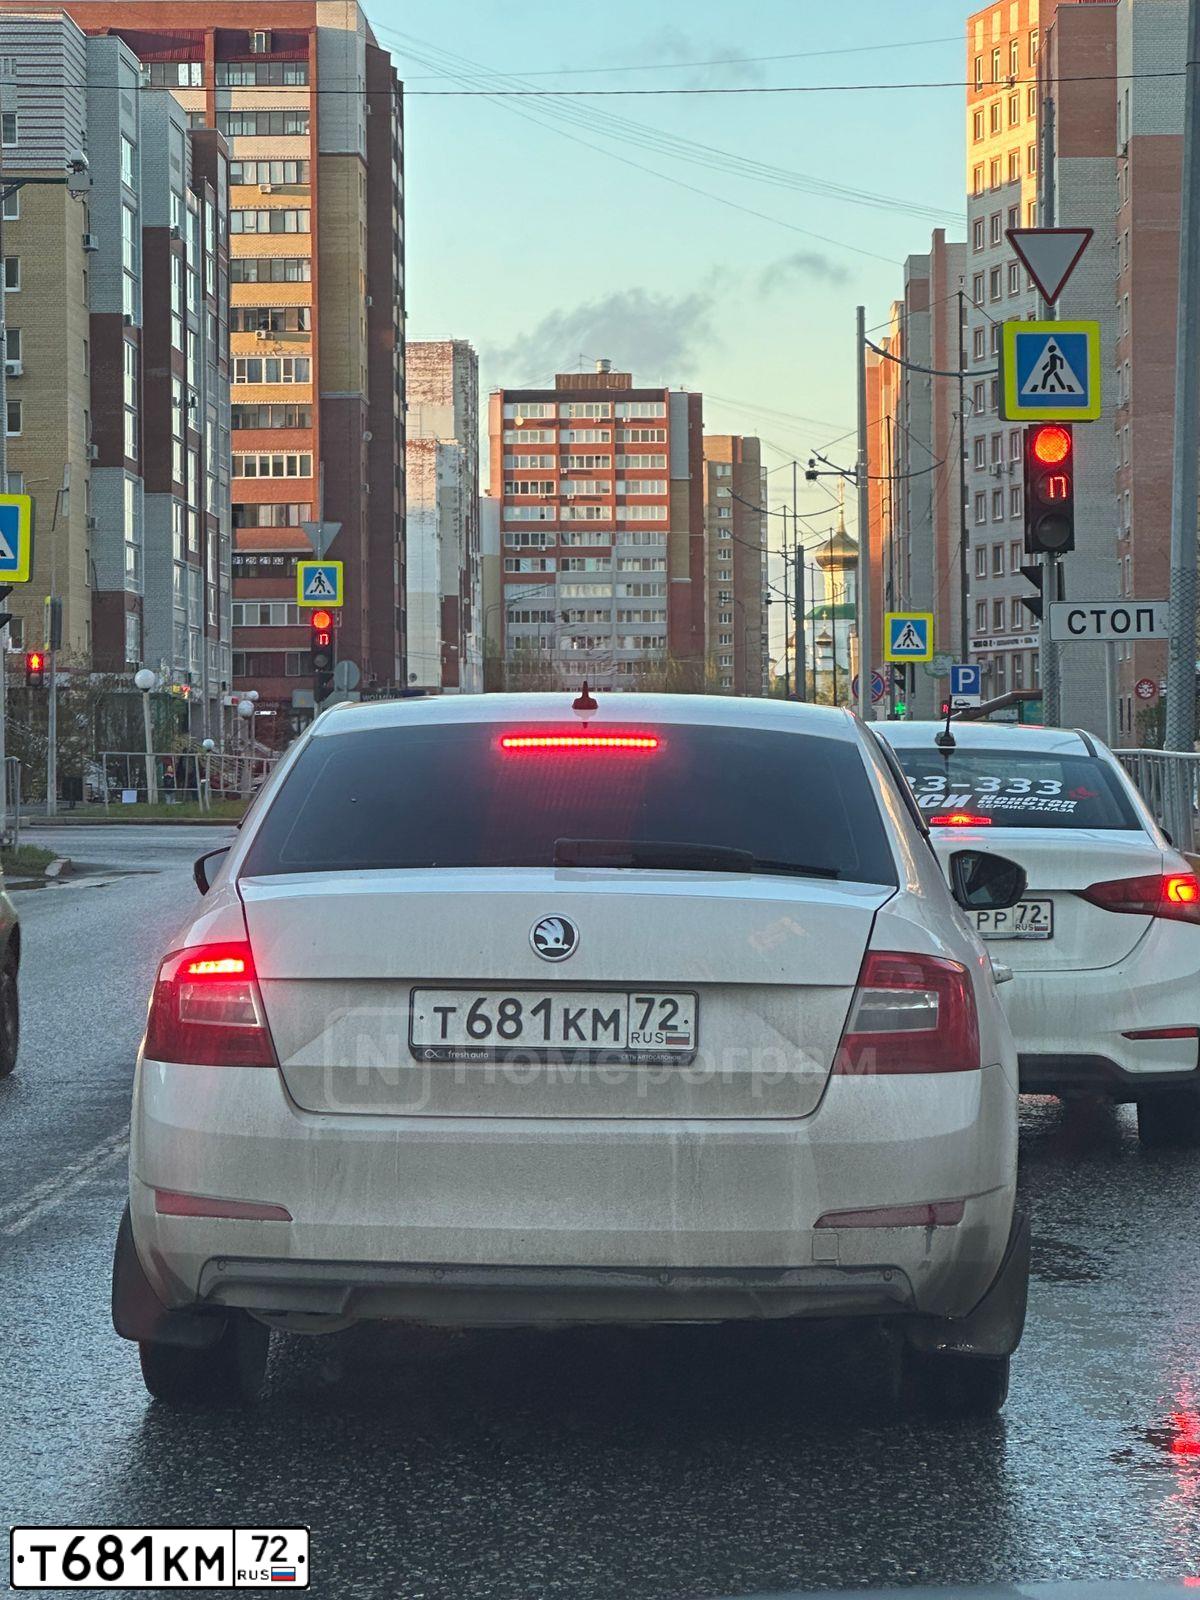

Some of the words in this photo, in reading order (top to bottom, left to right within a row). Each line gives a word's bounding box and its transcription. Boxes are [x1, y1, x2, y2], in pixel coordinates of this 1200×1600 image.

[1067, 609, 1154, 635] СТОП
[1016, 904, 1042, 923] 72
[433, 997, 621, 1042] Т681КМ
[635, 997, 679, 1031] 72
[631, 1032, 664, 1044] RUS
[448, 1050, 470, 1059] fresh
[470, 1051, 489, 1059] auto
